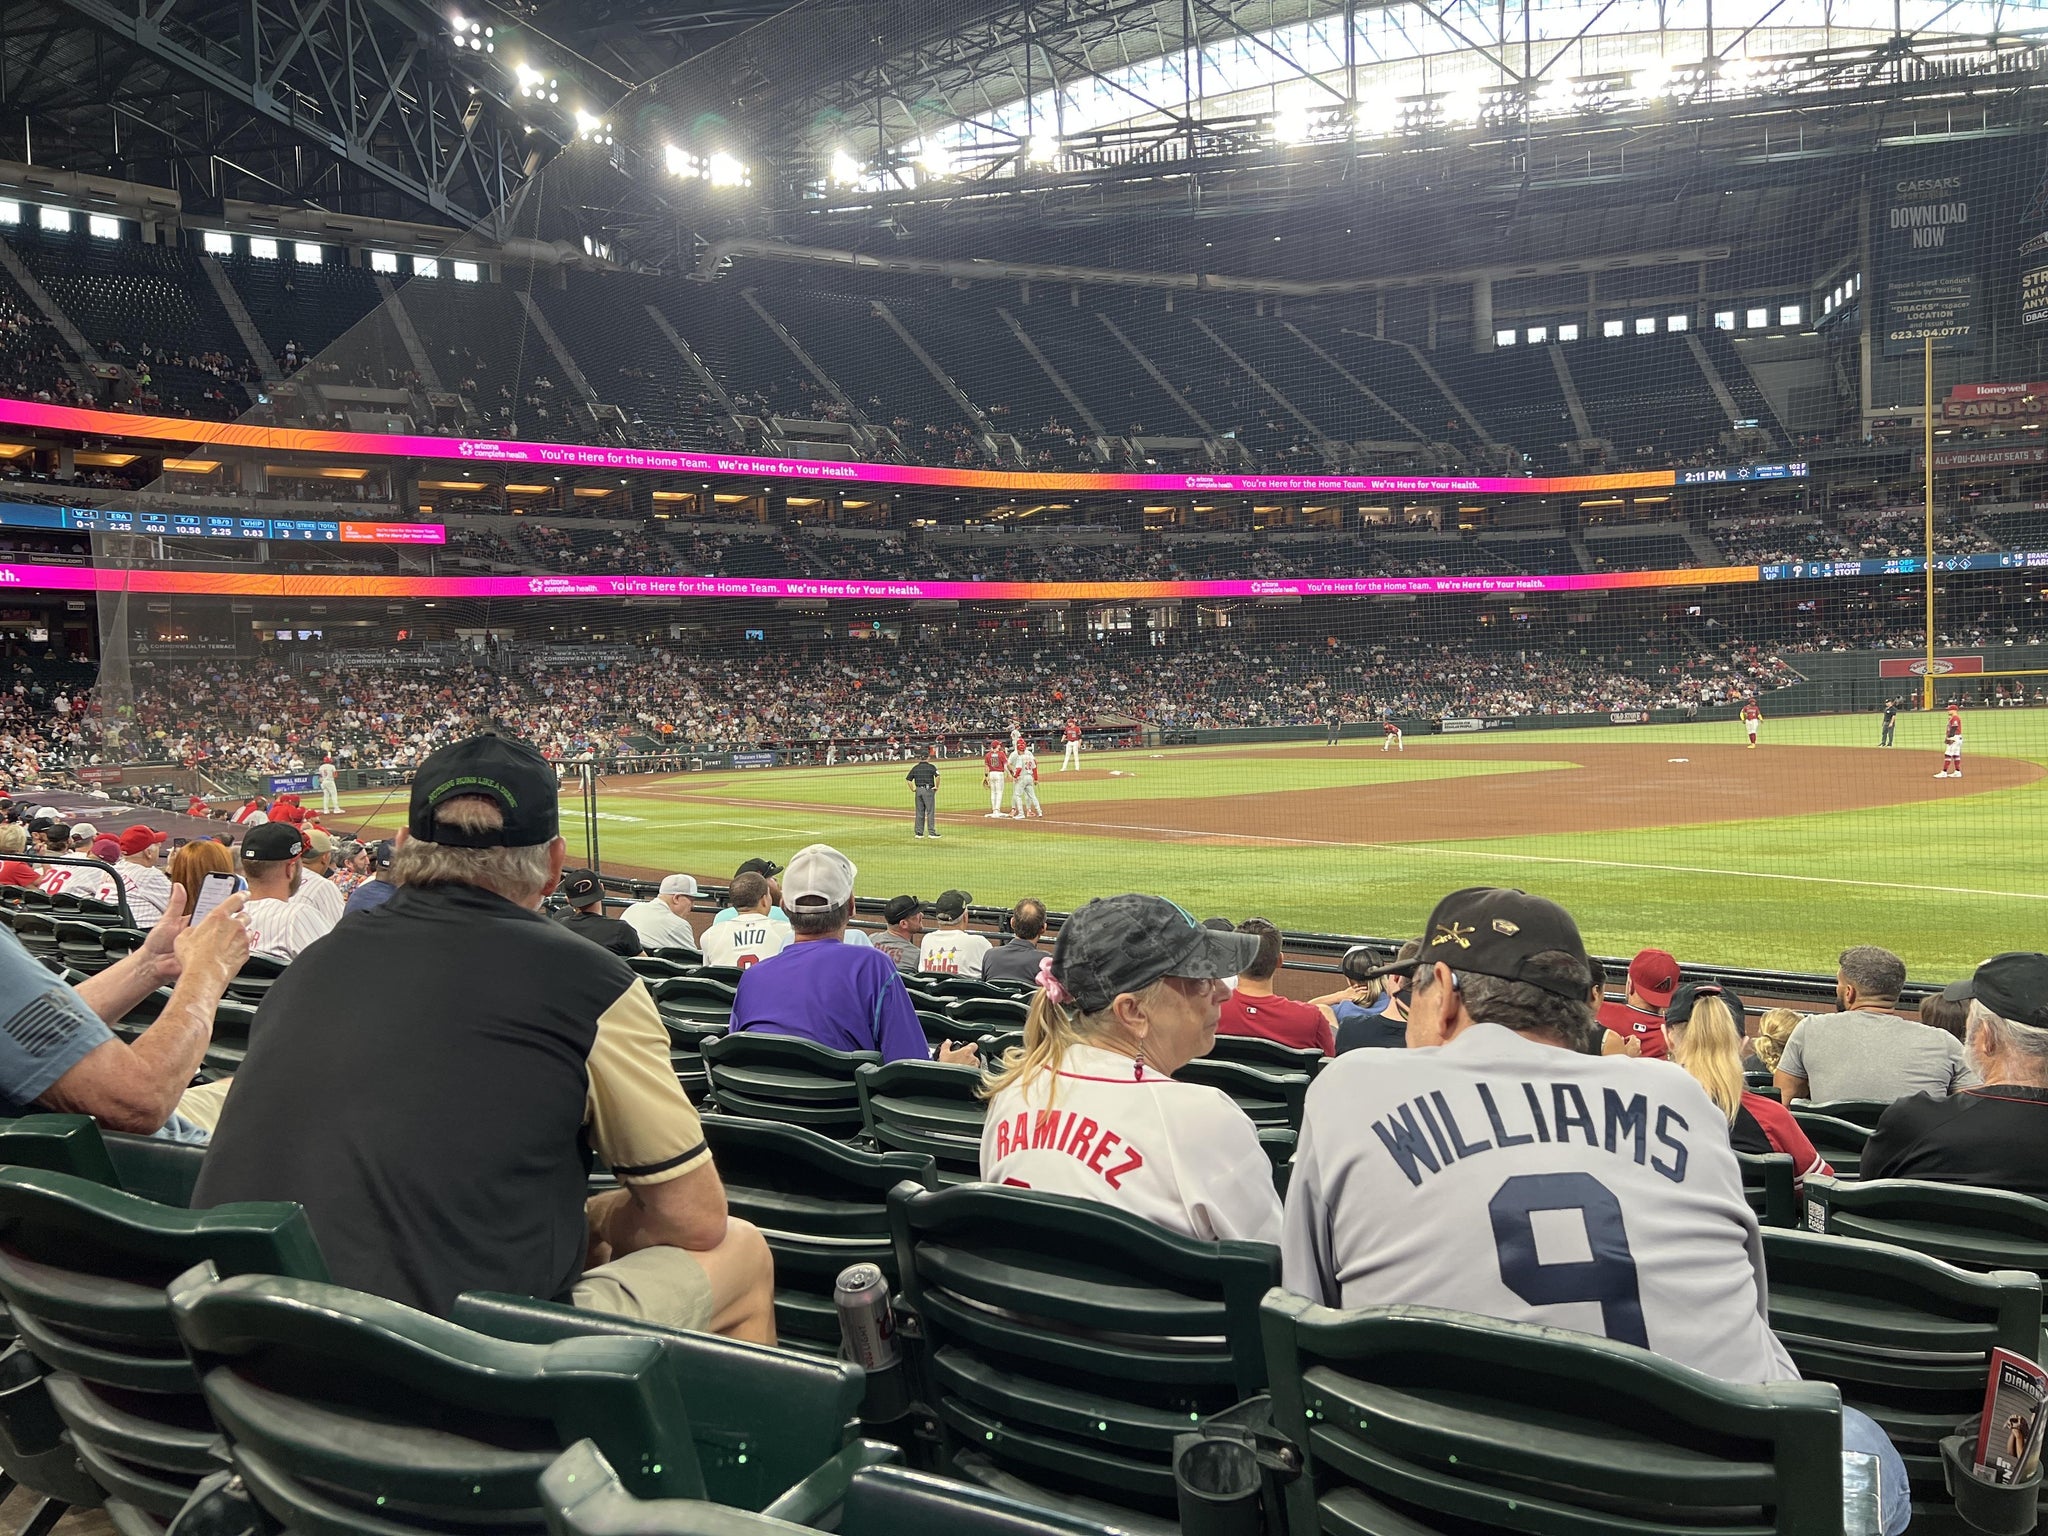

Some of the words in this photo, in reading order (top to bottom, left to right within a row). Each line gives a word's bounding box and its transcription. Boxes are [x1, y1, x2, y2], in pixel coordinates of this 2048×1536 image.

[1896, 177, 1961, 192] CAESARS
[1890, 203, 1967, 229] DOWNLOAD
[1912, 226, 1946, 249] NOW
[1916, 279, 1938, 287] Guest
[1940, 276, 1971, 285] Conduct
[1935, 286, 1962, 294] Texting
[2022, 285, 2047, 300] ANY
[1907, 310, 1953, 320] LOCATION
[1890, 326, 1970, 340] 623.304.0777
[1976, 384, 2027, 395] Honeywell
[474, 442, 499, 450] arizona
[474, 450, 505, 459] complete
[1935, 452, 2003, 465] ALL-YOU-CAN-EAT
[2004, 451, 2029, 461] SEATS
[540, 449, 575, 461] You're
[578, 452, 604, 462] Here
[607, 453, 623, 463] for
[625, 454, 644, 465] the
[646, 455, 678, 467] Home
[680, 458, 711, 469] Team.
[717, 460, 749, 471] We're
[752, 462, 776, 472] Here
[778, 463, 794, 473] for
[795, 464, 819, 475] Your
[822, 466, 858, 477] Health.
[1685, 472, 1705, 482] 2:11
[1707, 470, 1726, 481] PM
[1241, 479, 1266, 488] You're
[1269, 480, 1288, 488] Here
[1290, 480, 1301, 488] for
[1303, 480, 1316, 488] the
[1318, 480, 1342, 489] Home
[1343, 480, 1367, 489] Team.
[1371, 480, 1395, 489] We're
[1397, 481, 1416, 489] Here
[1418, 480, 1429, 489] for
[1430, 481, 1450, 489] Your
[1451, 481, 1480, 489] Health.
[76, 520, 94, 529] 0-1
[110, 522, 132, 531] 2.25
[145, 524, 165, 533] 40.0
[211, 527, 232, 535] 2.25
[243, 529, 264, 537] 0.83
[282, 530, 289, 538] 3
[304, 530, 312, 538] 5
[326, 531, 333, 539] 8
[2002, 557, 2009, 565] 6
[1762, 565, 1779, 573] DUE
[1811, 566, 1818, 575] 5
[1834, 568, 1860, 577] STOTT
[1765, 572, 1777, 580] UP
[544, 578, 569, 586] arizona
[1307, 583, 1332, 591] You're
[1334, 583, 1353, 591] Here
[1355, 582, 1366, 590] for
[1368, 582, 1382, 590] the
[1383, 582, 1406, 590] Home
[1408, 581, 1432, 590] Team.
[1436, 580, 1460, 589] We're
[1462, 581, 1481, 589] Here
[1483, 580, 1494, 588] for
[1496, 580, 1515, 588] Your
[1516, 579, 1546, 588] Health.
[544, 585, 575, 594] complete
[610, 580, 647, 591] You're
[650, 581, 676, 591] Here
[678, 581, 693, 591] for
[696, 582, 715, 592] the
[717, 583, 748, 593] Home
[749, 583, 780, 593] Team.
[787, 583, 818, 594] We're
[820, 584, 844, 594] Here
[845, 584, 861, 594] for
[862, 585, 886, 594] Your
[888, 584, 923, 595] Health.
[478, 777, 494, 787] LIKE
[494, 782, 500, 790] A
[734, 929, 766, 947] NITO
[1371, 1082, 1689, 1187] WILLIAMS
[997, 1109, 1143, 1191] RAMIREZ
[1808, 1218, 1825, 1231] FOOD
[1488, 1172, 1651, 1351] 9
